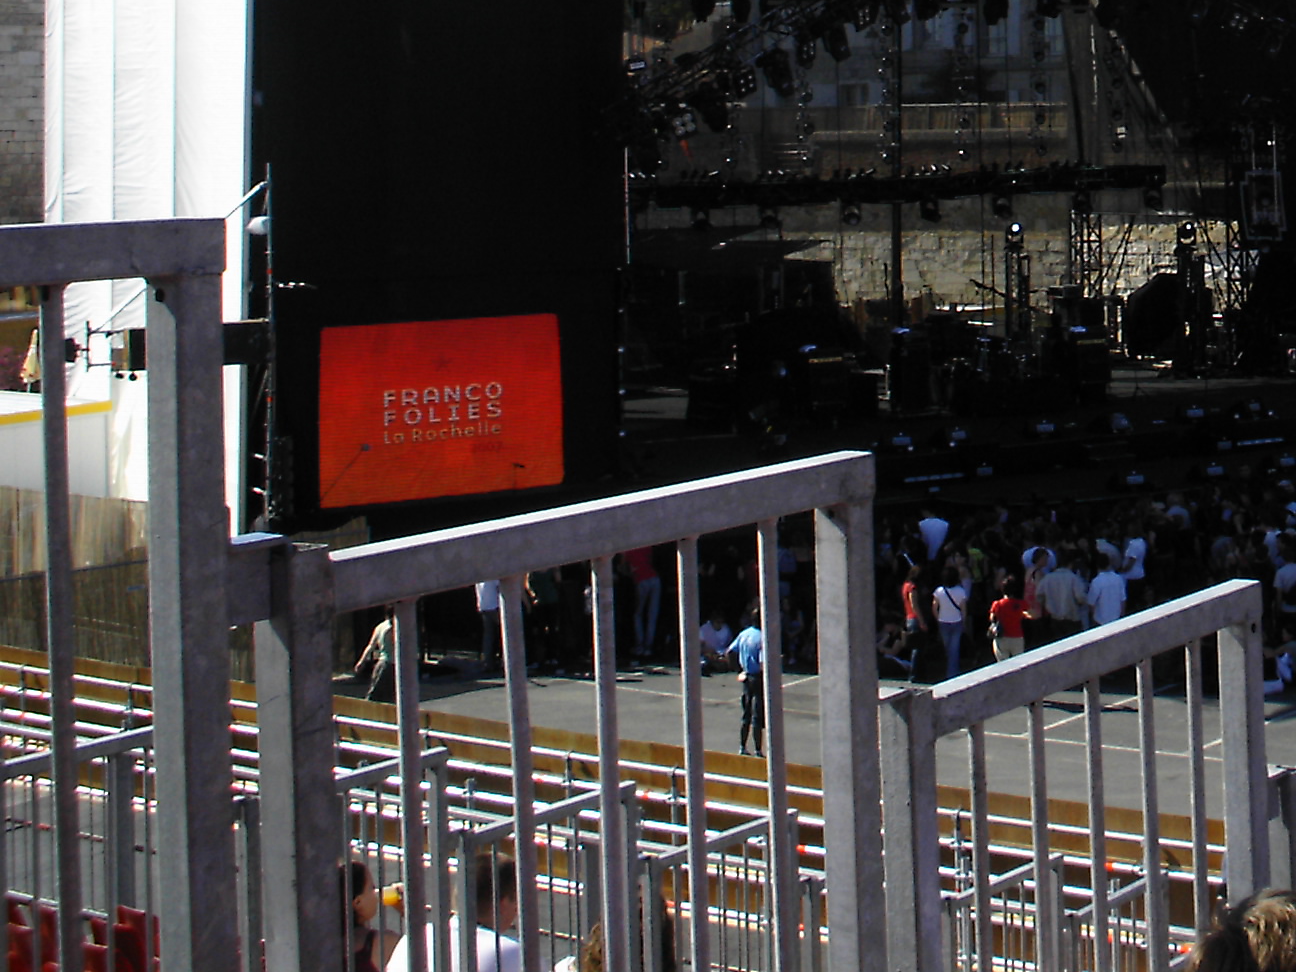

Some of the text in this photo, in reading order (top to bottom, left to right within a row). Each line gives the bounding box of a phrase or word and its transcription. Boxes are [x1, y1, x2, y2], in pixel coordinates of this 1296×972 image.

[384, 382, 502, 407] FRANCO
[384, 401, 502, 427] FOLIES
[384, 421, 502, 445] La Rochelle
